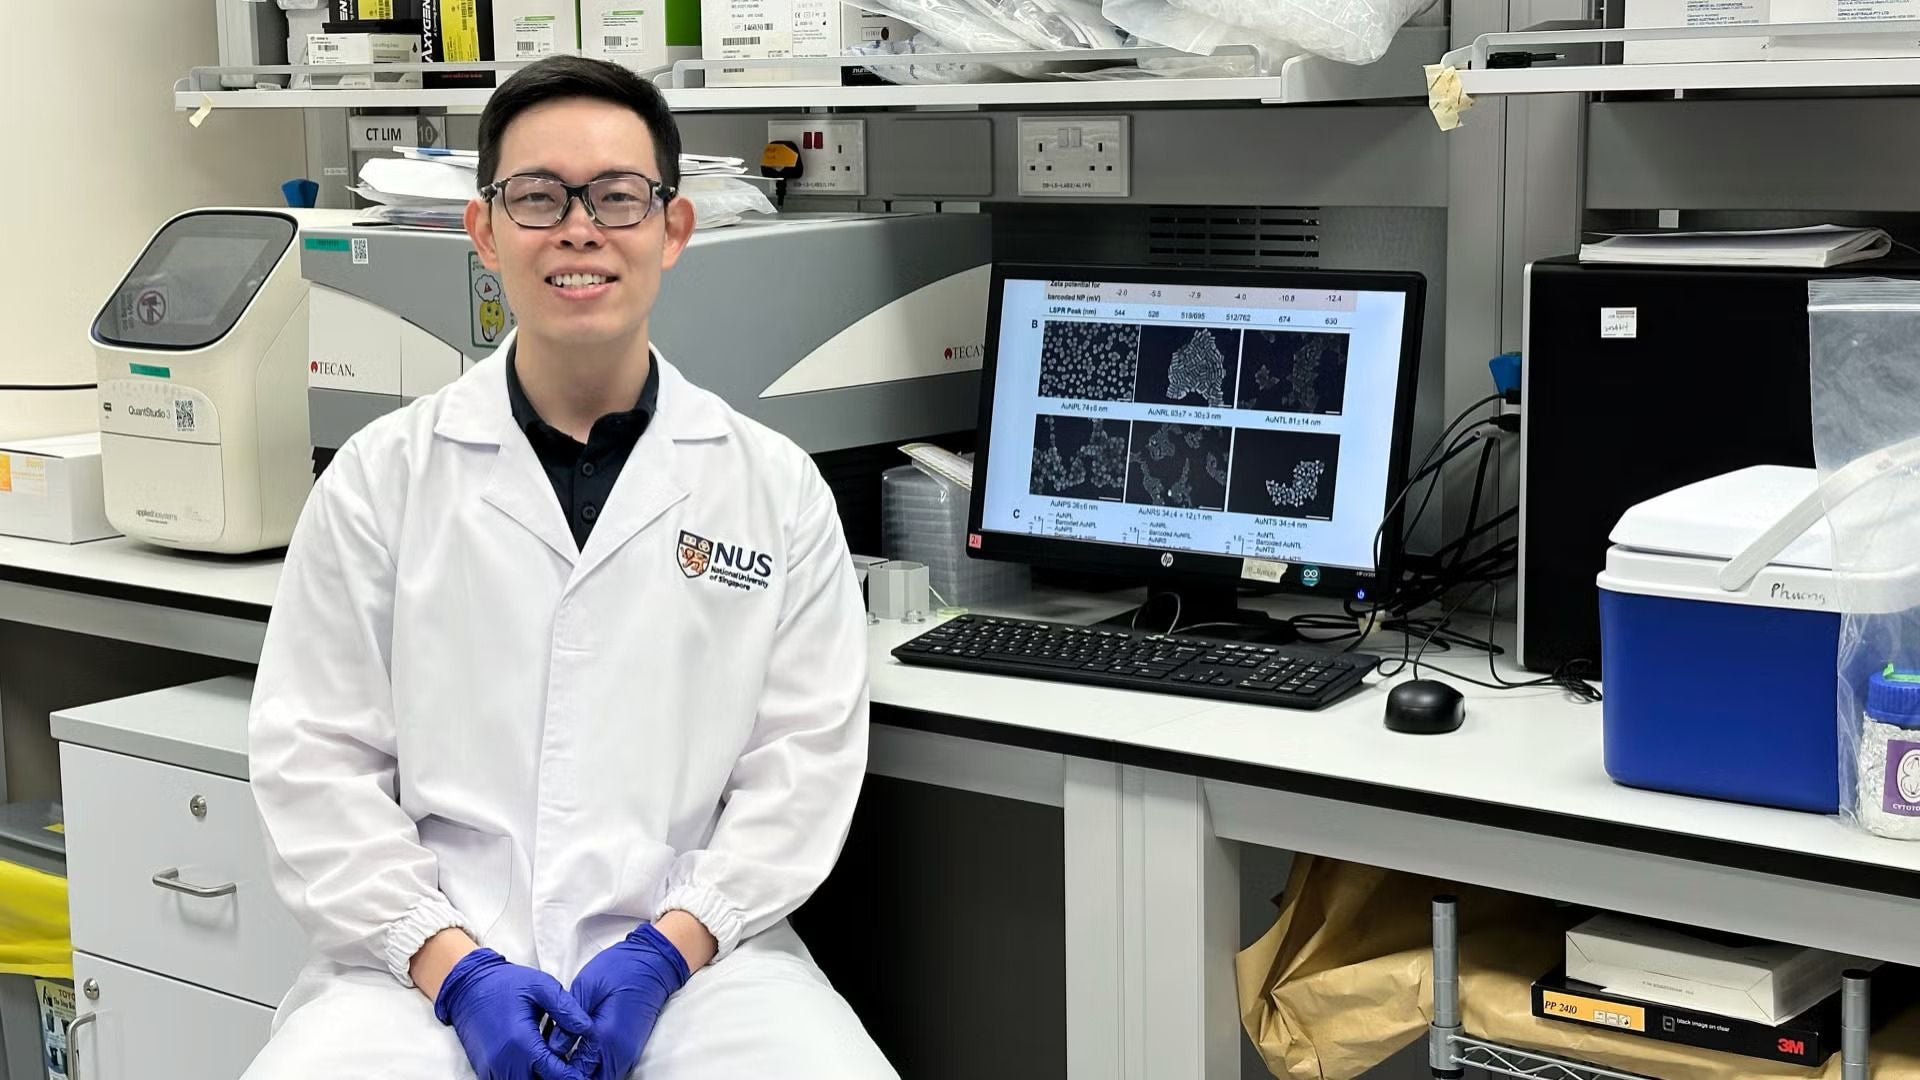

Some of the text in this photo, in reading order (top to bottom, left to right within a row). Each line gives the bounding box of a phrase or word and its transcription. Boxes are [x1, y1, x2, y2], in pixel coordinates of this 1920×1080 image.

[365, 128, 402, 141] CT LIM
[418, 126, 433, 142] 10
[1049, 306, 1066, 314] LSPR
[1067, 307, 1081, 315] Peak
[1031, 320, 1038, 328] B
[128, 405, 165, 419] QuantStudio
[1013, 509, 1020, 519] C
[714, 542, 772, 578] NUS
[711, 565, 769, 589] National University
[719, 576, 750, 591] Singapore
[1544, 1000, 1577, 1015] PP 2410
[1676, 1017, 1691, 1026] black
[1691, 1020, 1708, 1029] image
[1777, 1038, 1805, 1056] 3M
